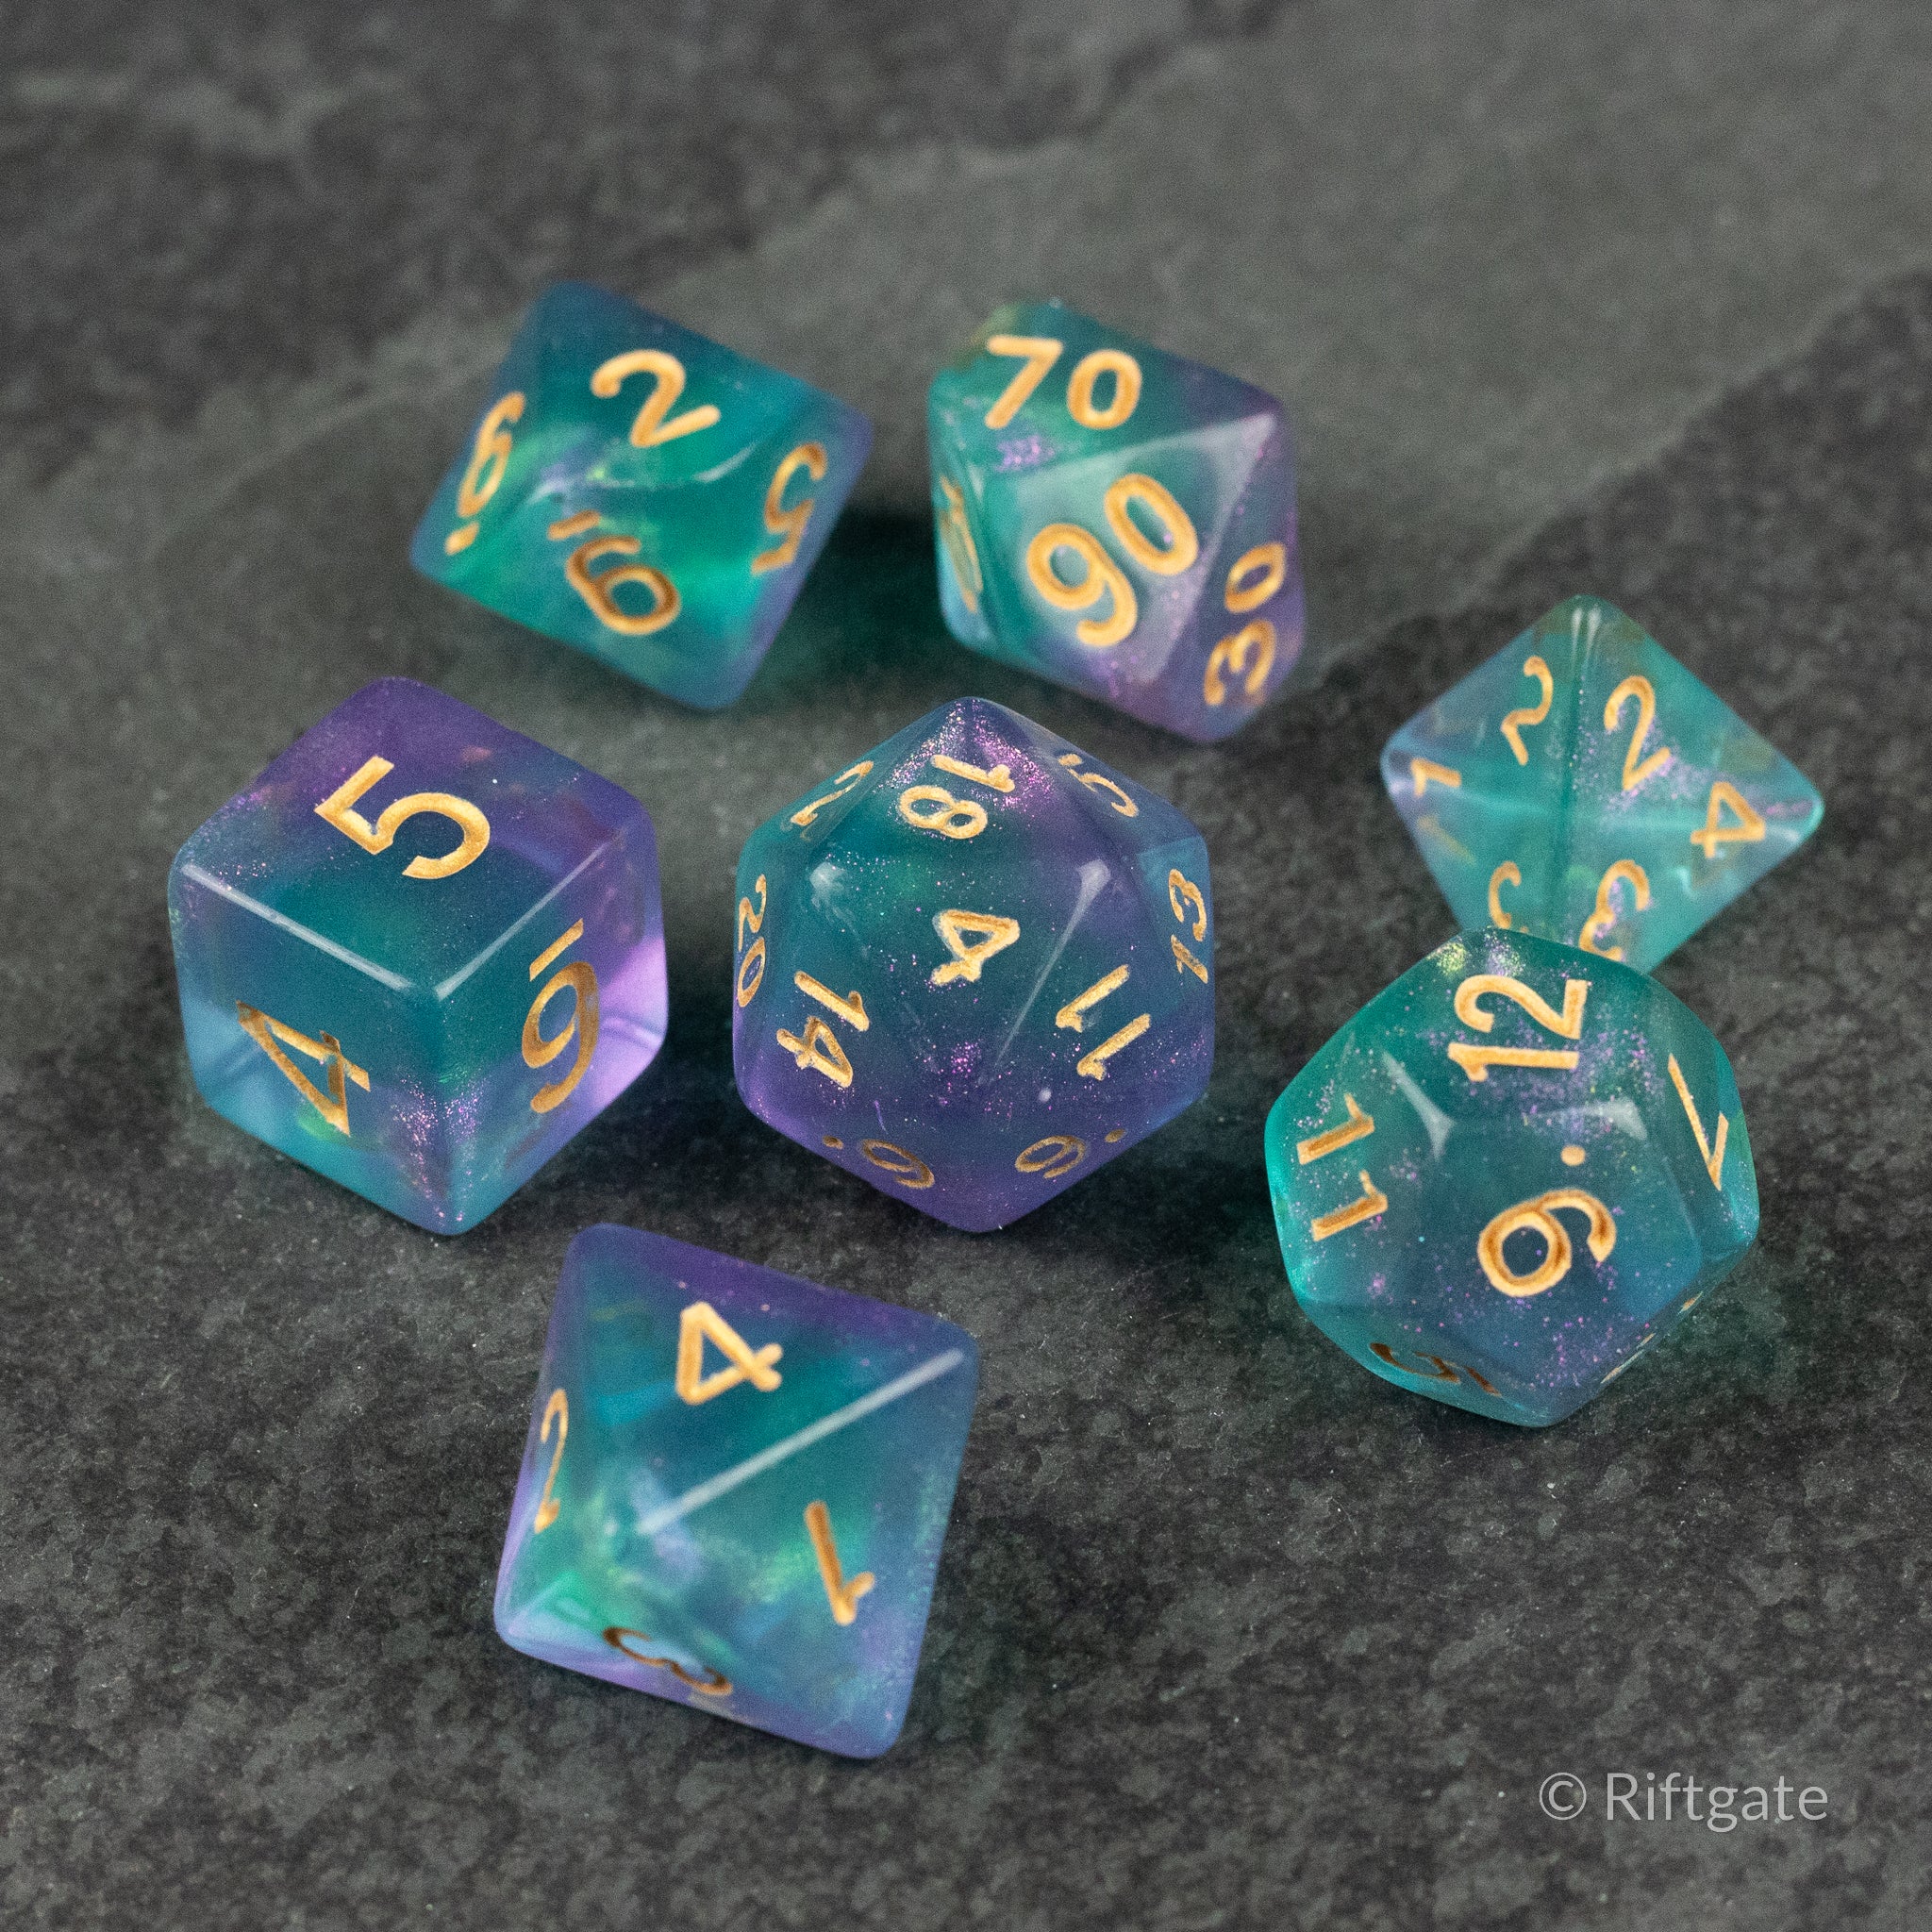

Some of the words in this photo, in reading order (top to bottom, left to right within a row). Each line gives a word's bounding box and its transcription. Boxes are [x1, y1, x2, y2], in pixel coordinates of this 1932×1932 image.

[591, 349, 721, 447] 2
[985, 334, 1143, 430] 70
[751, 441, 827, 577] 5
[1025, 474, 1199, 647] 90
[1204, 541, 1287, 708] 30
[1501, 656, 1554, 766] 2
[1604, 675, 1671, 791] 2
[314, 754, 491, 880] 5
[899, 753, 1015, 840] 18
[1690, 781, 1766, 858] 4
[929, 908, 1020, 986] 4
[1168, 868, 1209, 985] 13
[235, 999, 371, 1138] 4
[776, 970, 871, 1089] 14
[1055, 963, 1151, 1082] 11
[1446, 974, 1589, 1083] 12
[1296, 1092, 1389, 1242] 11
[674, 1300, 783, 1406] 4
[532, 1388, 570, 1536] 2
[803, 1499, 877, 1626] 1
